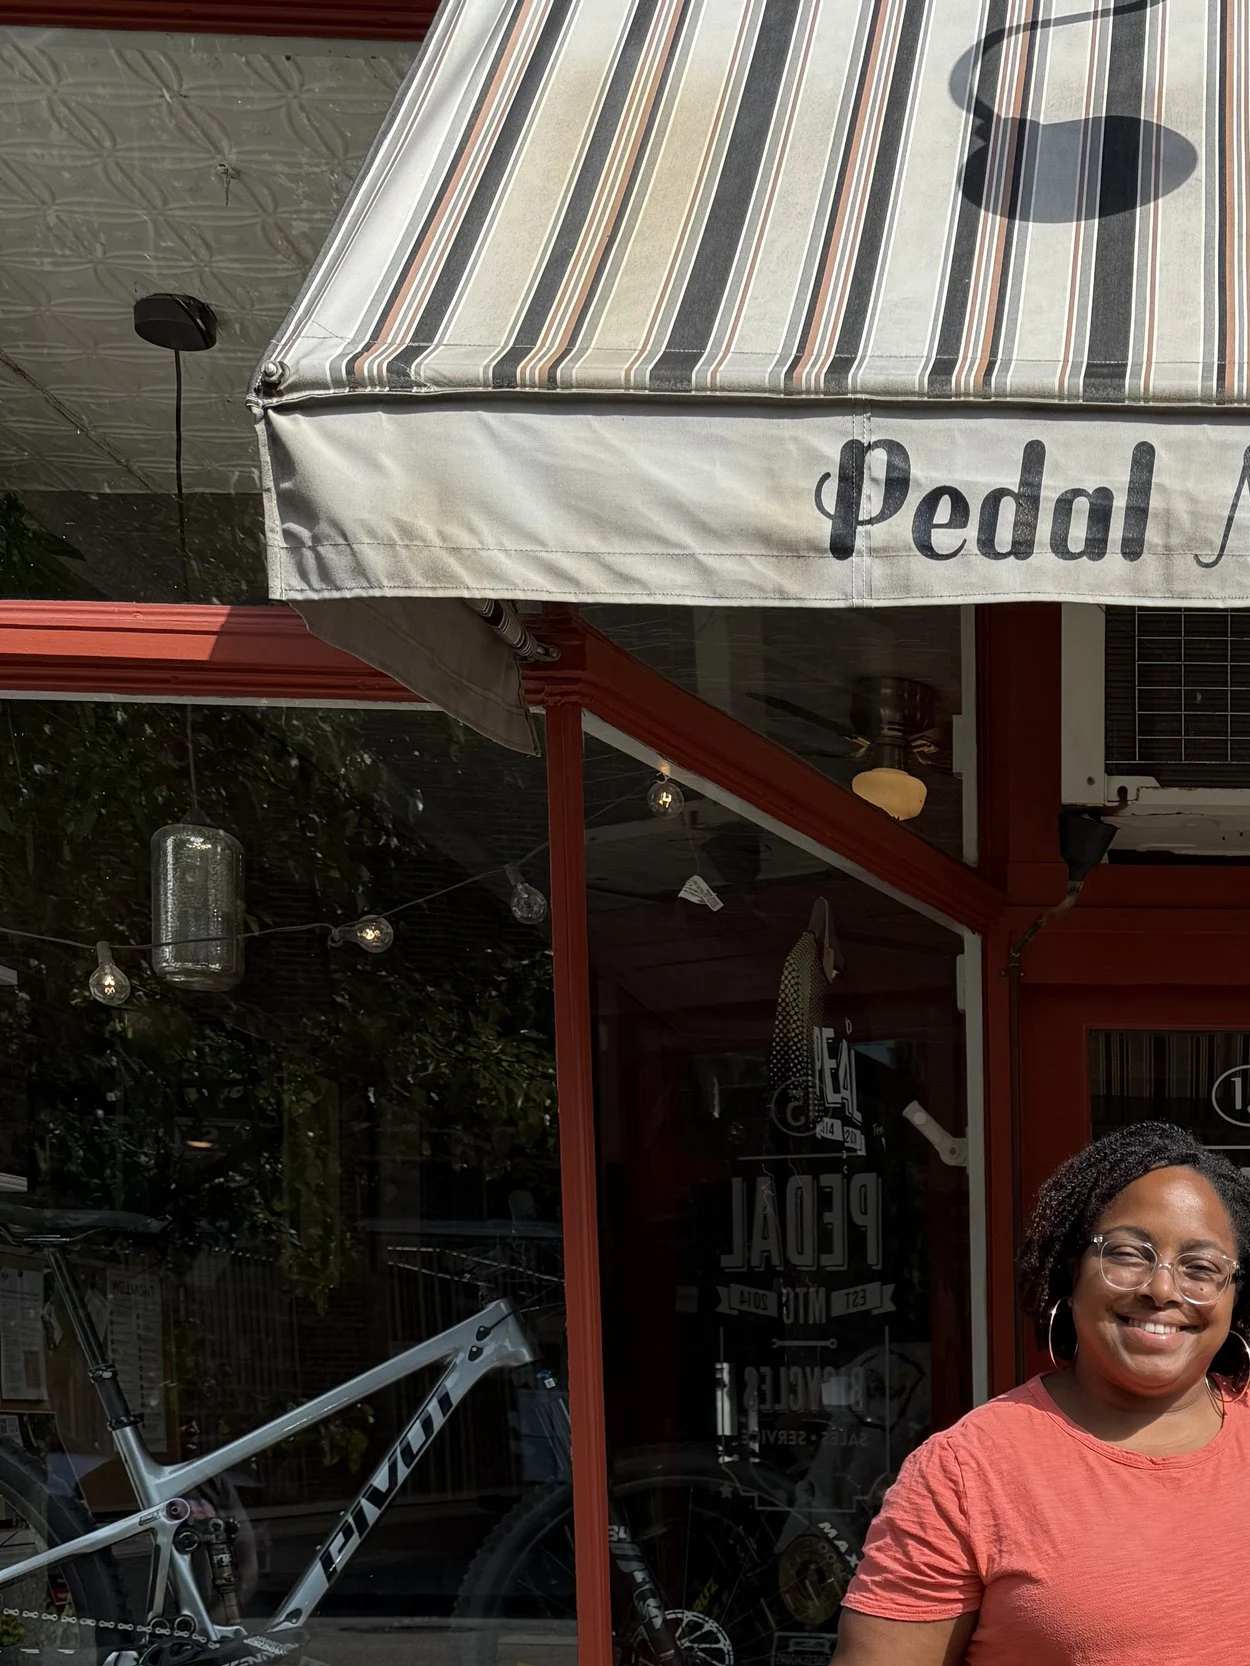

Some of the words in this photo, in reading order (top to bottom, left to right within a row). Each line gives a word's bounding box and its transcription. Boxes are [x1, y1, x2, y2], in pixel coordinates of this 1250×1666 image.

[814, 437, 1157, 563] Pedal
[319, 1358, 457, 1587] PIVOT
[817, 1521, 861, 1569] MAX
